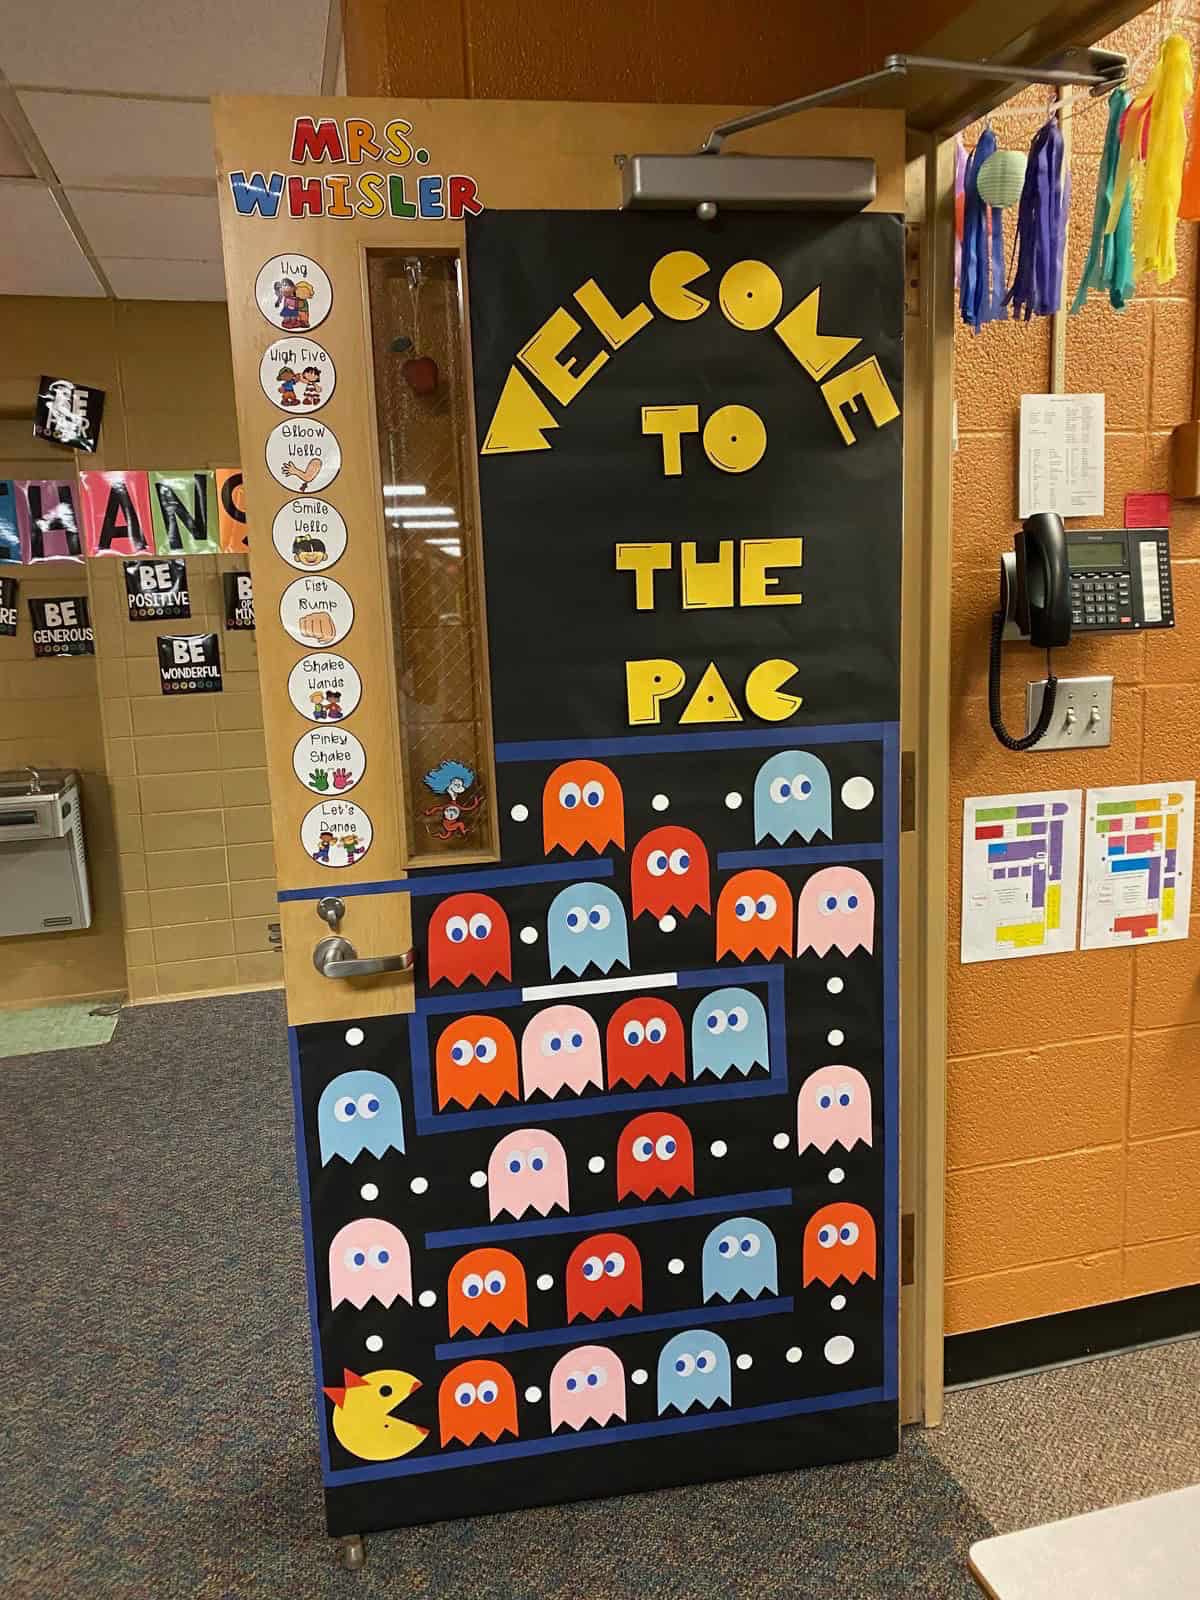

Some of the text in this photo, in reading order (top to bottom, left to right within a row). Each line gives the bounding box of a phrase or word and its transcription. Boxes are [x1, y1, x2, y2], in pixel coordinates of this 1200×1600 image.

[290, 116, 430, 166] MRS.
[229, 170, 484, 219] WHISLER
[281, 261, 308, 277] Hug
[270, 349, 327, 364] High Five
[480, 250, 901, 454] WELCOME
[282, 424, 325, 438] Elbow
[641, 404, 767, 475] TO
[288, 444, 322, 457] Hello
[293, 501, 329, 515] Smile
[294, 520, 328, 533] Hello
[140, 563, 172, 591] BE
[615, 537, 802, 610] THE
[305, 579, 328, 592] Fist
[128, 591, 190, 608] POSITIVE
[298, 599, 337, 612] Bump
[45, 601, 77, 627] BE
[33, 628, 94, 643] GENEROUS
[172, 639, 205, 664] BE
[161, 665, 221, 680] WONDERFUL
[303, 659, 345, 673] Shake
[308, 677, 344, 689] Hands
[625, 658, 802, 725] PAC
[311, 733, 348, 745] Pinky
[310, 751, 351, 763] Shake
[321, 804, 355, 816] Let's
[320, 821, 357, 833] Dance
